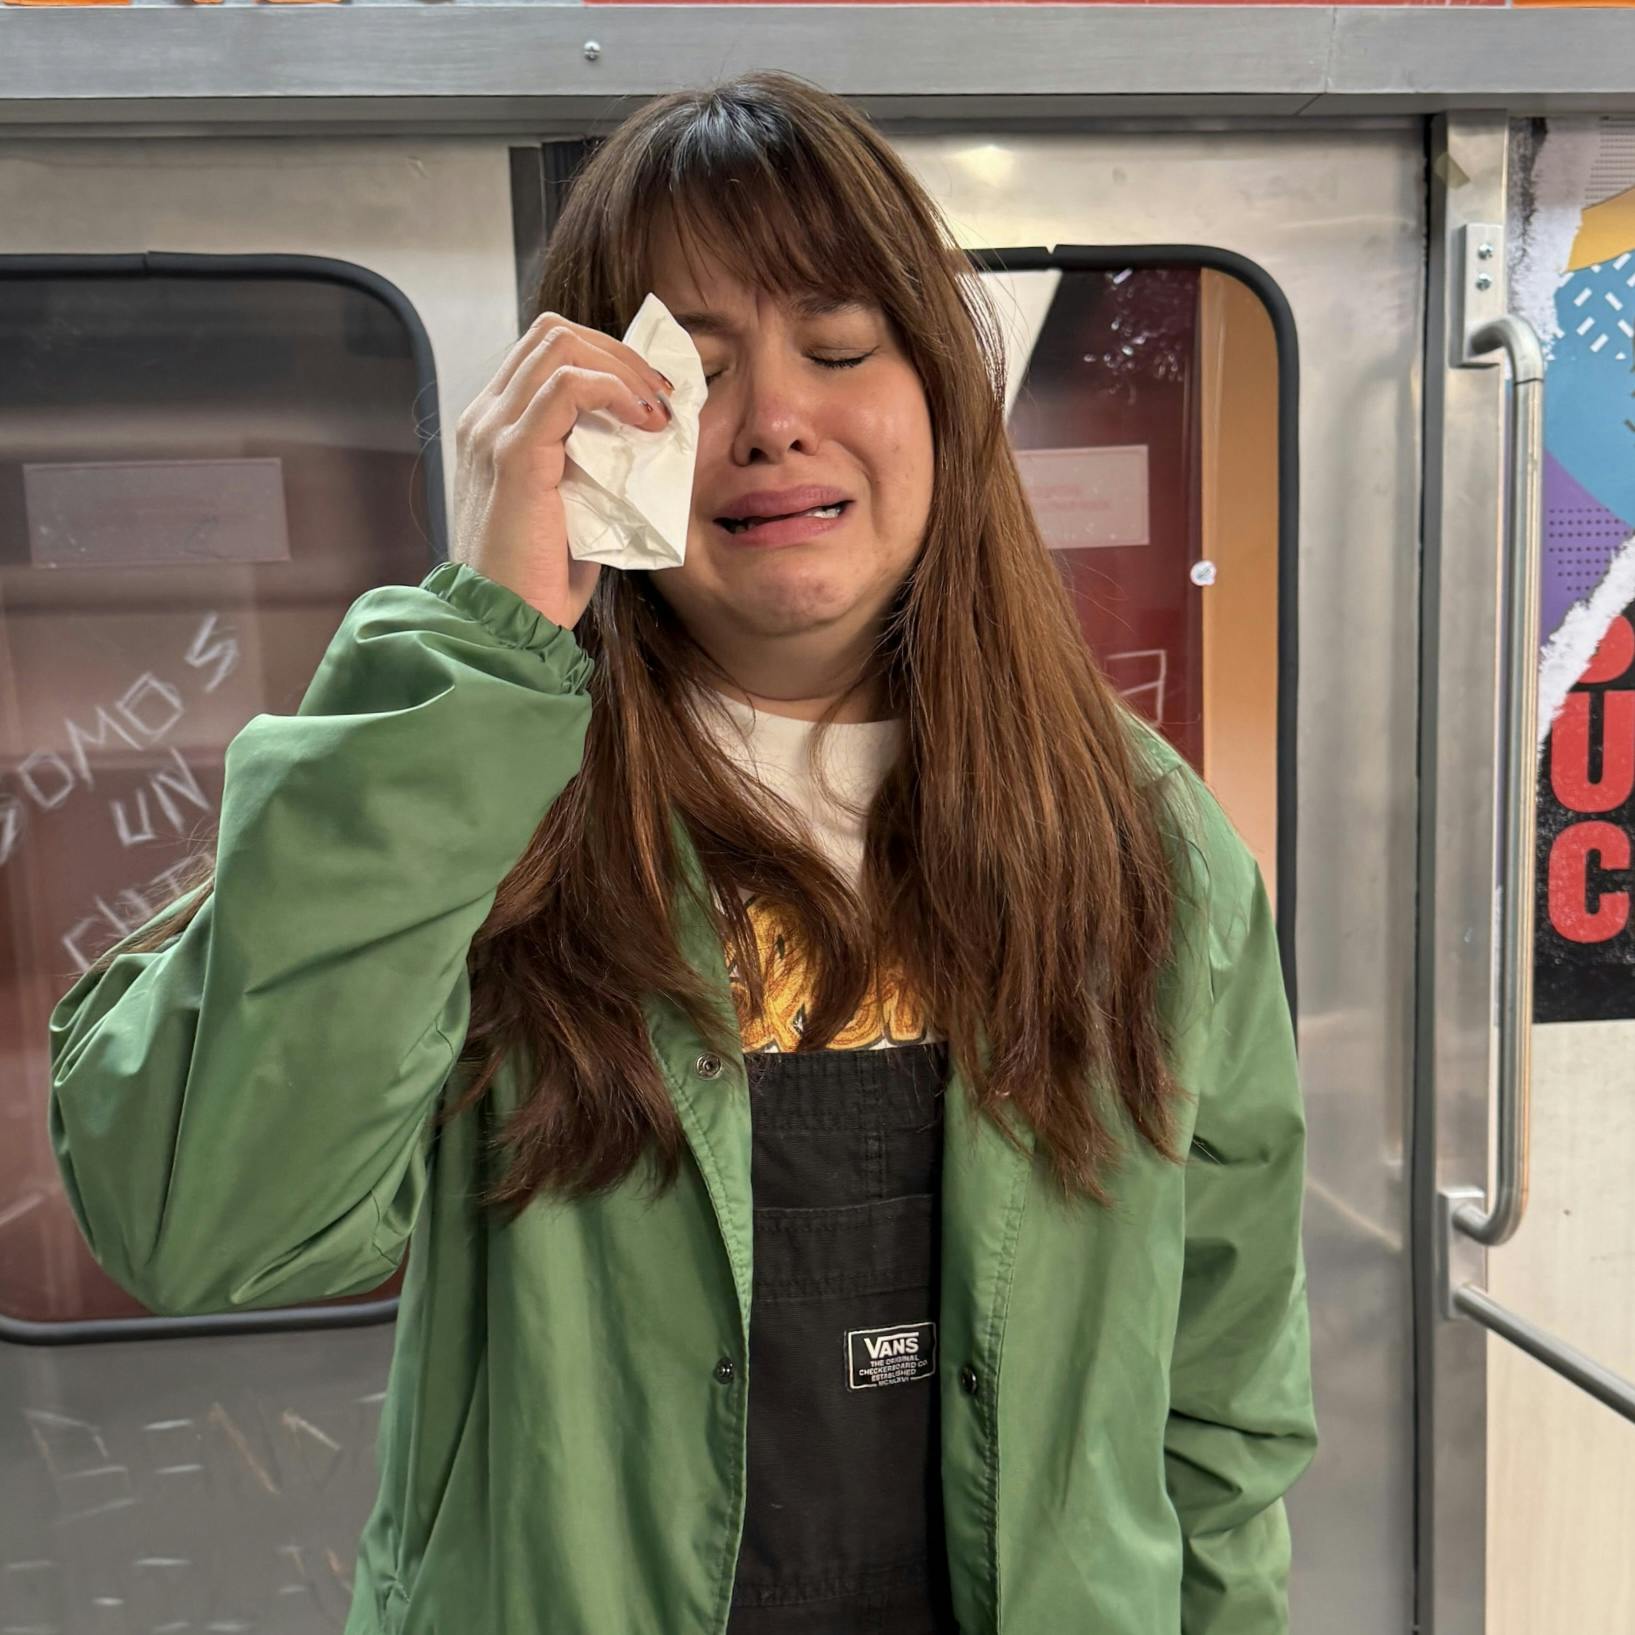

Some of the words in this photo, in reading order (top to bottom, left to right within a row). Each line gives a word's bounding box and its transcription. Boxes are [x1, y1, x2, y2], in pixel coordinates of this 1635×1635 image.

[110, 746, 212, 847] UN
[864, 1332, 919, 1359] VANS
[886, 1355, 920, 1365] ORIGINAL
[859, 1362, 917, 1376] CHECKERBOARD
[871, 1369, 916, 1382] ESTABLISHED
